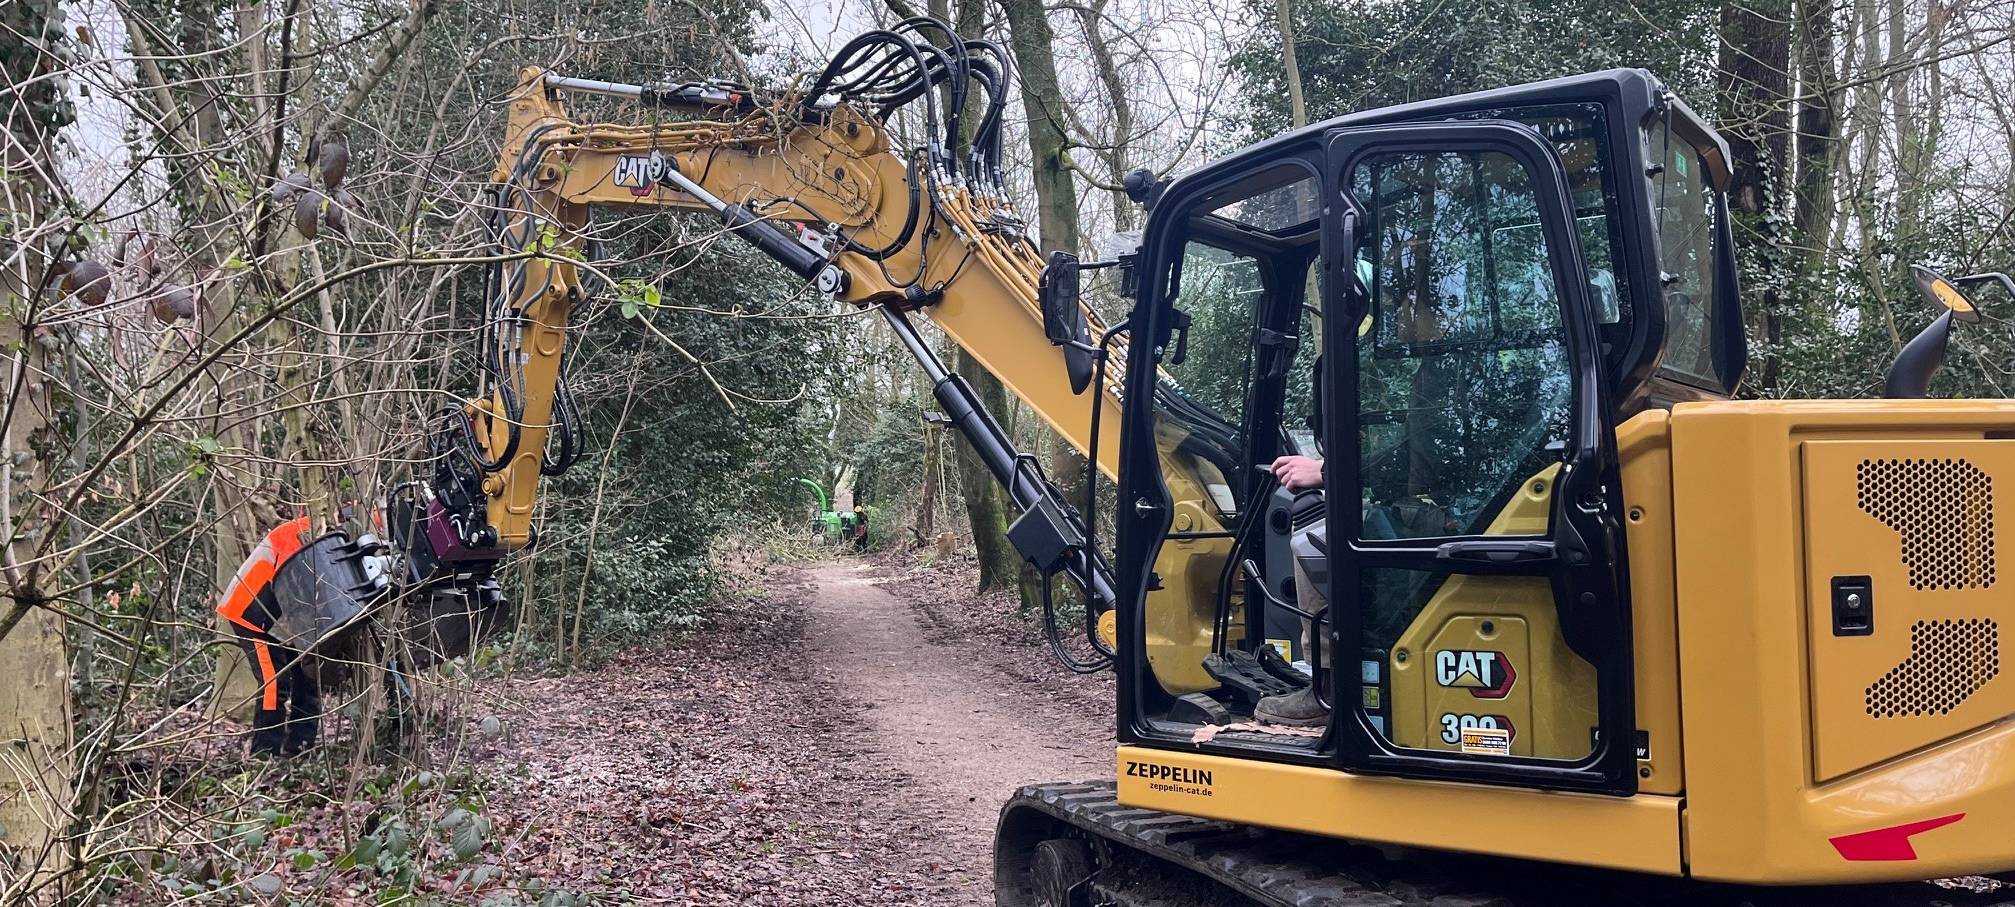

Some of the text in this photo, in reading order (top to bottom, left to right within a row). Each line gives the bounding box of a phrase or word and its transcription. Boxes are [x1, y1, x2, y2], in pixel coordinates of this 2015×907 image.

[615, 156, 649, 187] CAT
[1436, 650, 1495, 687] CAT
[1126, 761, 1213, 786] ZEPPELIN
[1150, 782, 1213, 796] zeppelin-cat.de
